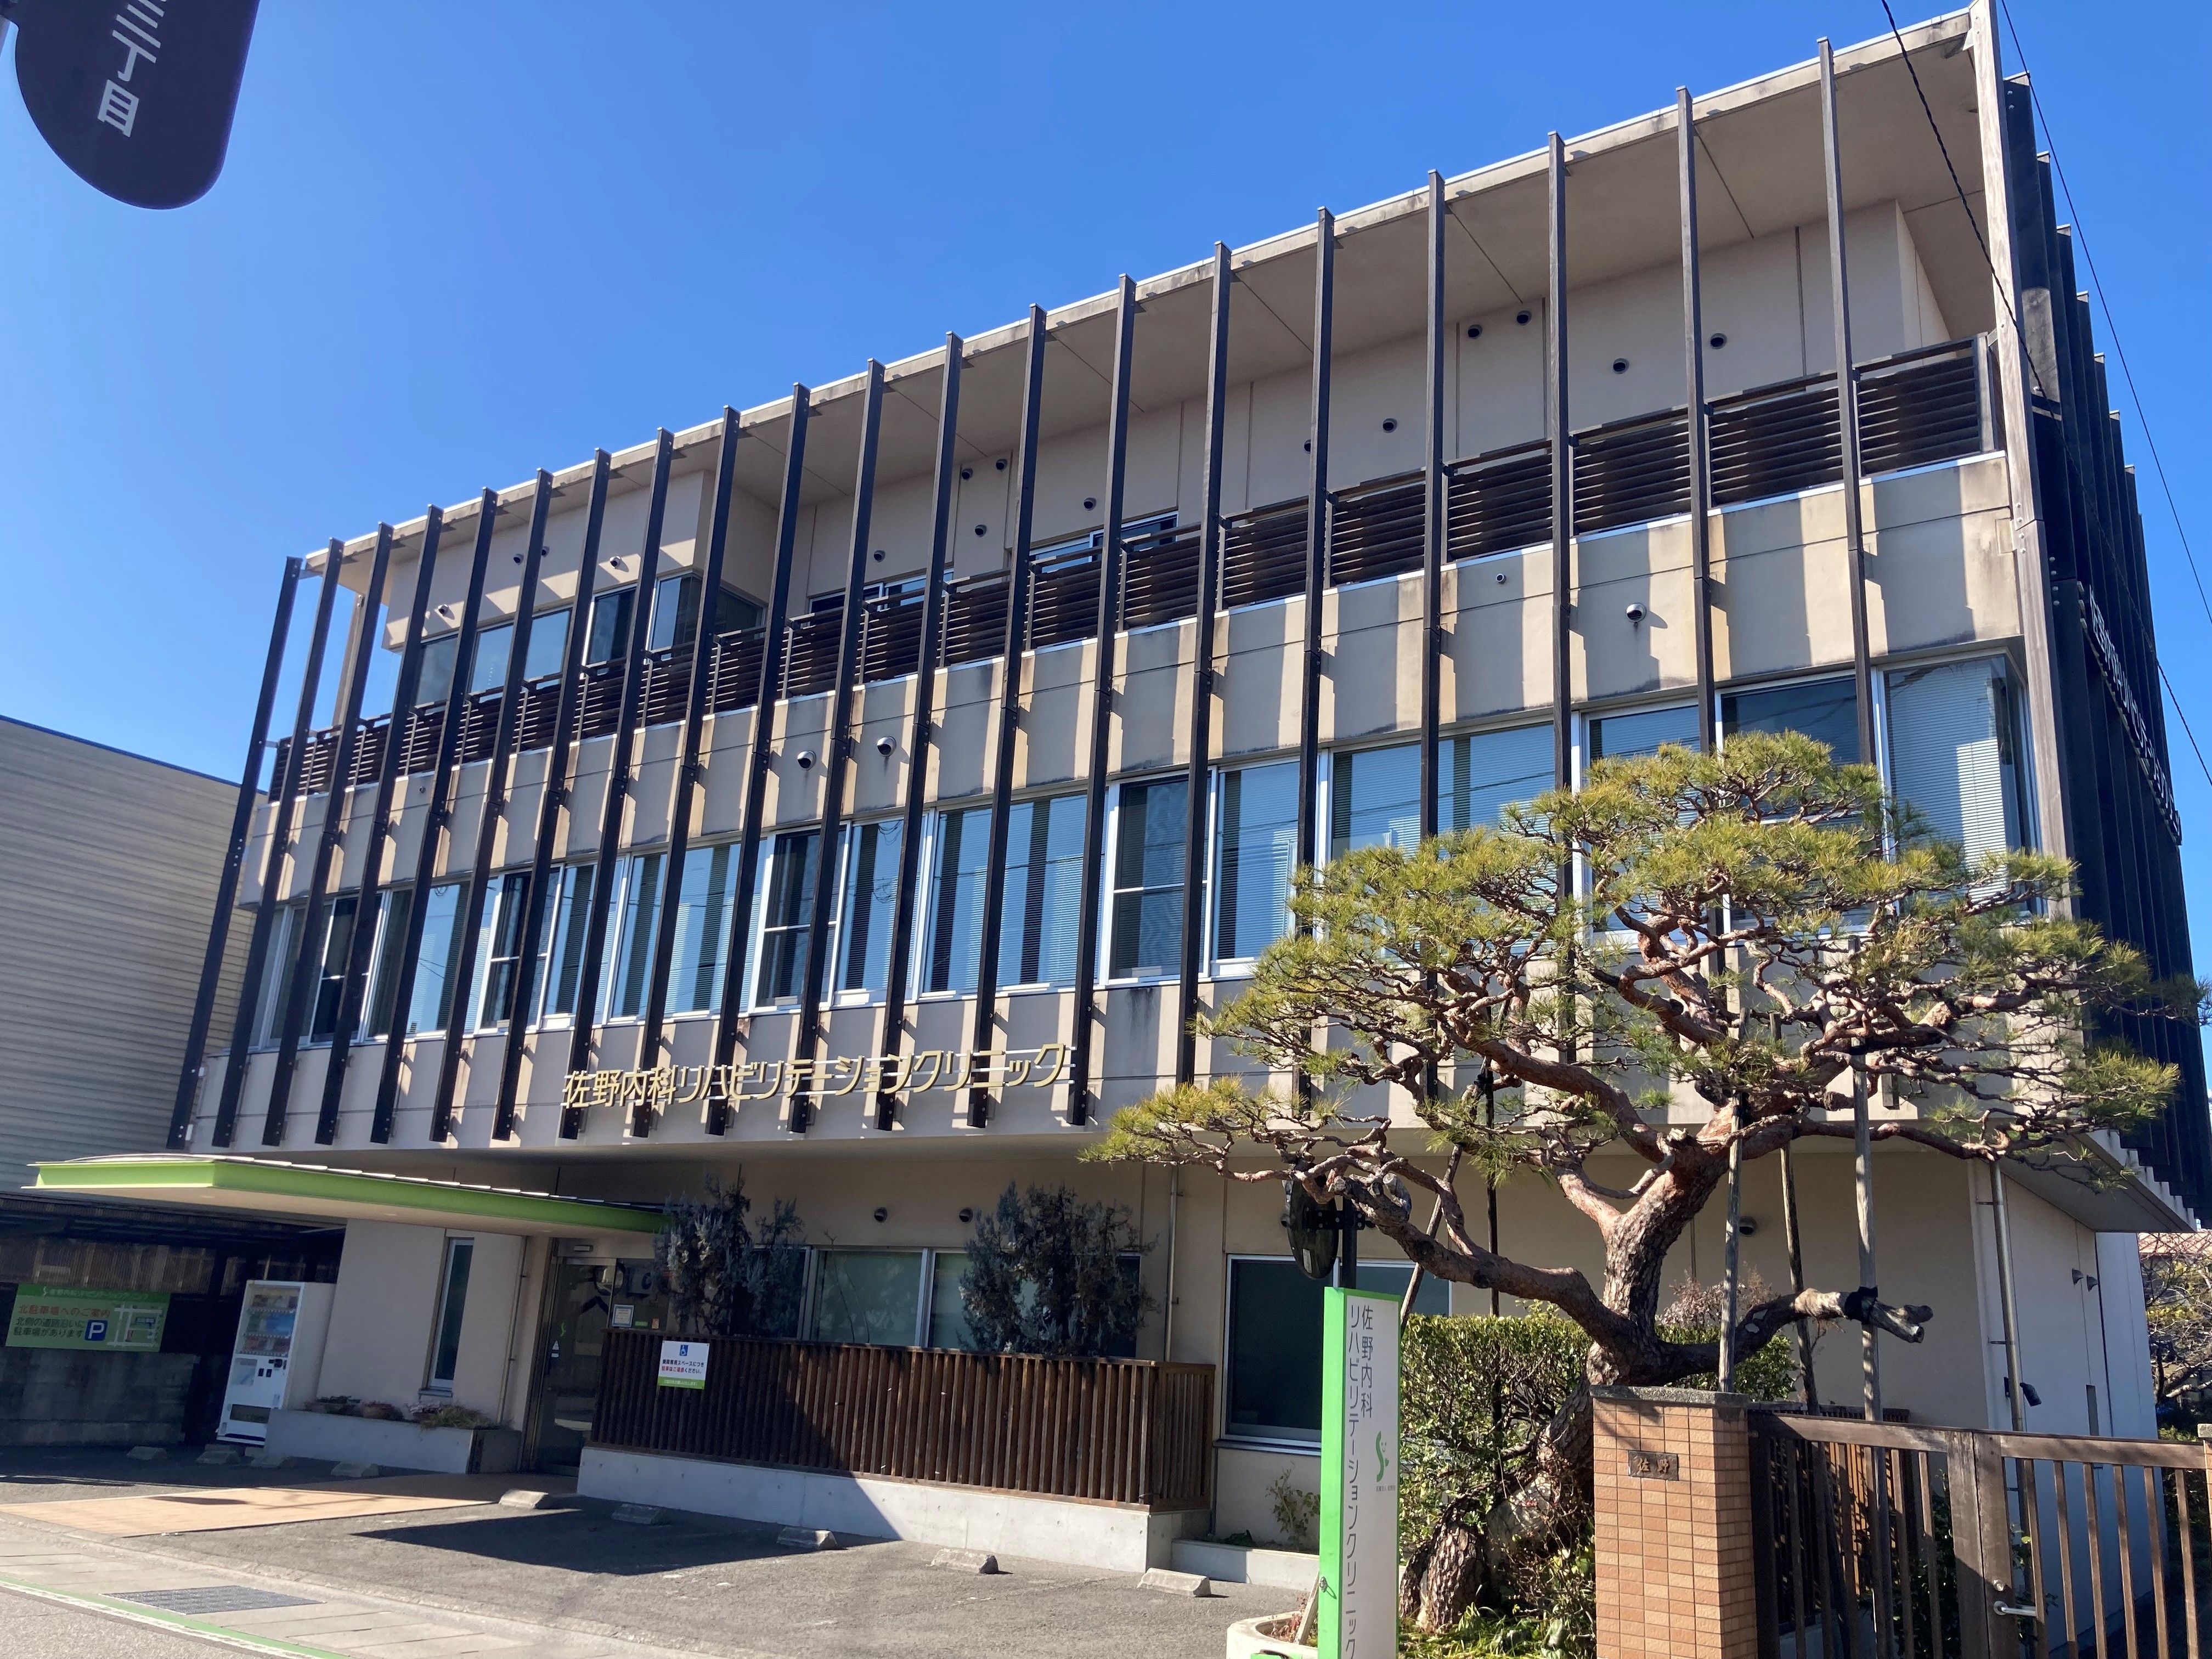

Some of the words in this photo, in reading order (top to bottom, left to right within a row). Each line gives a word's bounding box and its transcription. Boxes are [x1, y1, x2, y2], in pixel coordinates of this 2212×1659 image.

[97, 0, 166, 137] 三丁目
[564, 1043, 1065, 1108] 佐野内科リハビリテーションクリニック
[19, 1305, 110, 1318] 北駐車場へのご案内
[88, 1322, 104, 1339] P
[1362, 1305, 1373, 1419] 佐野内科
[1345, 1305, 1359, 1659] リハビリテーションクリニック
[1637, 1458, 1669, 1474] 佐野
